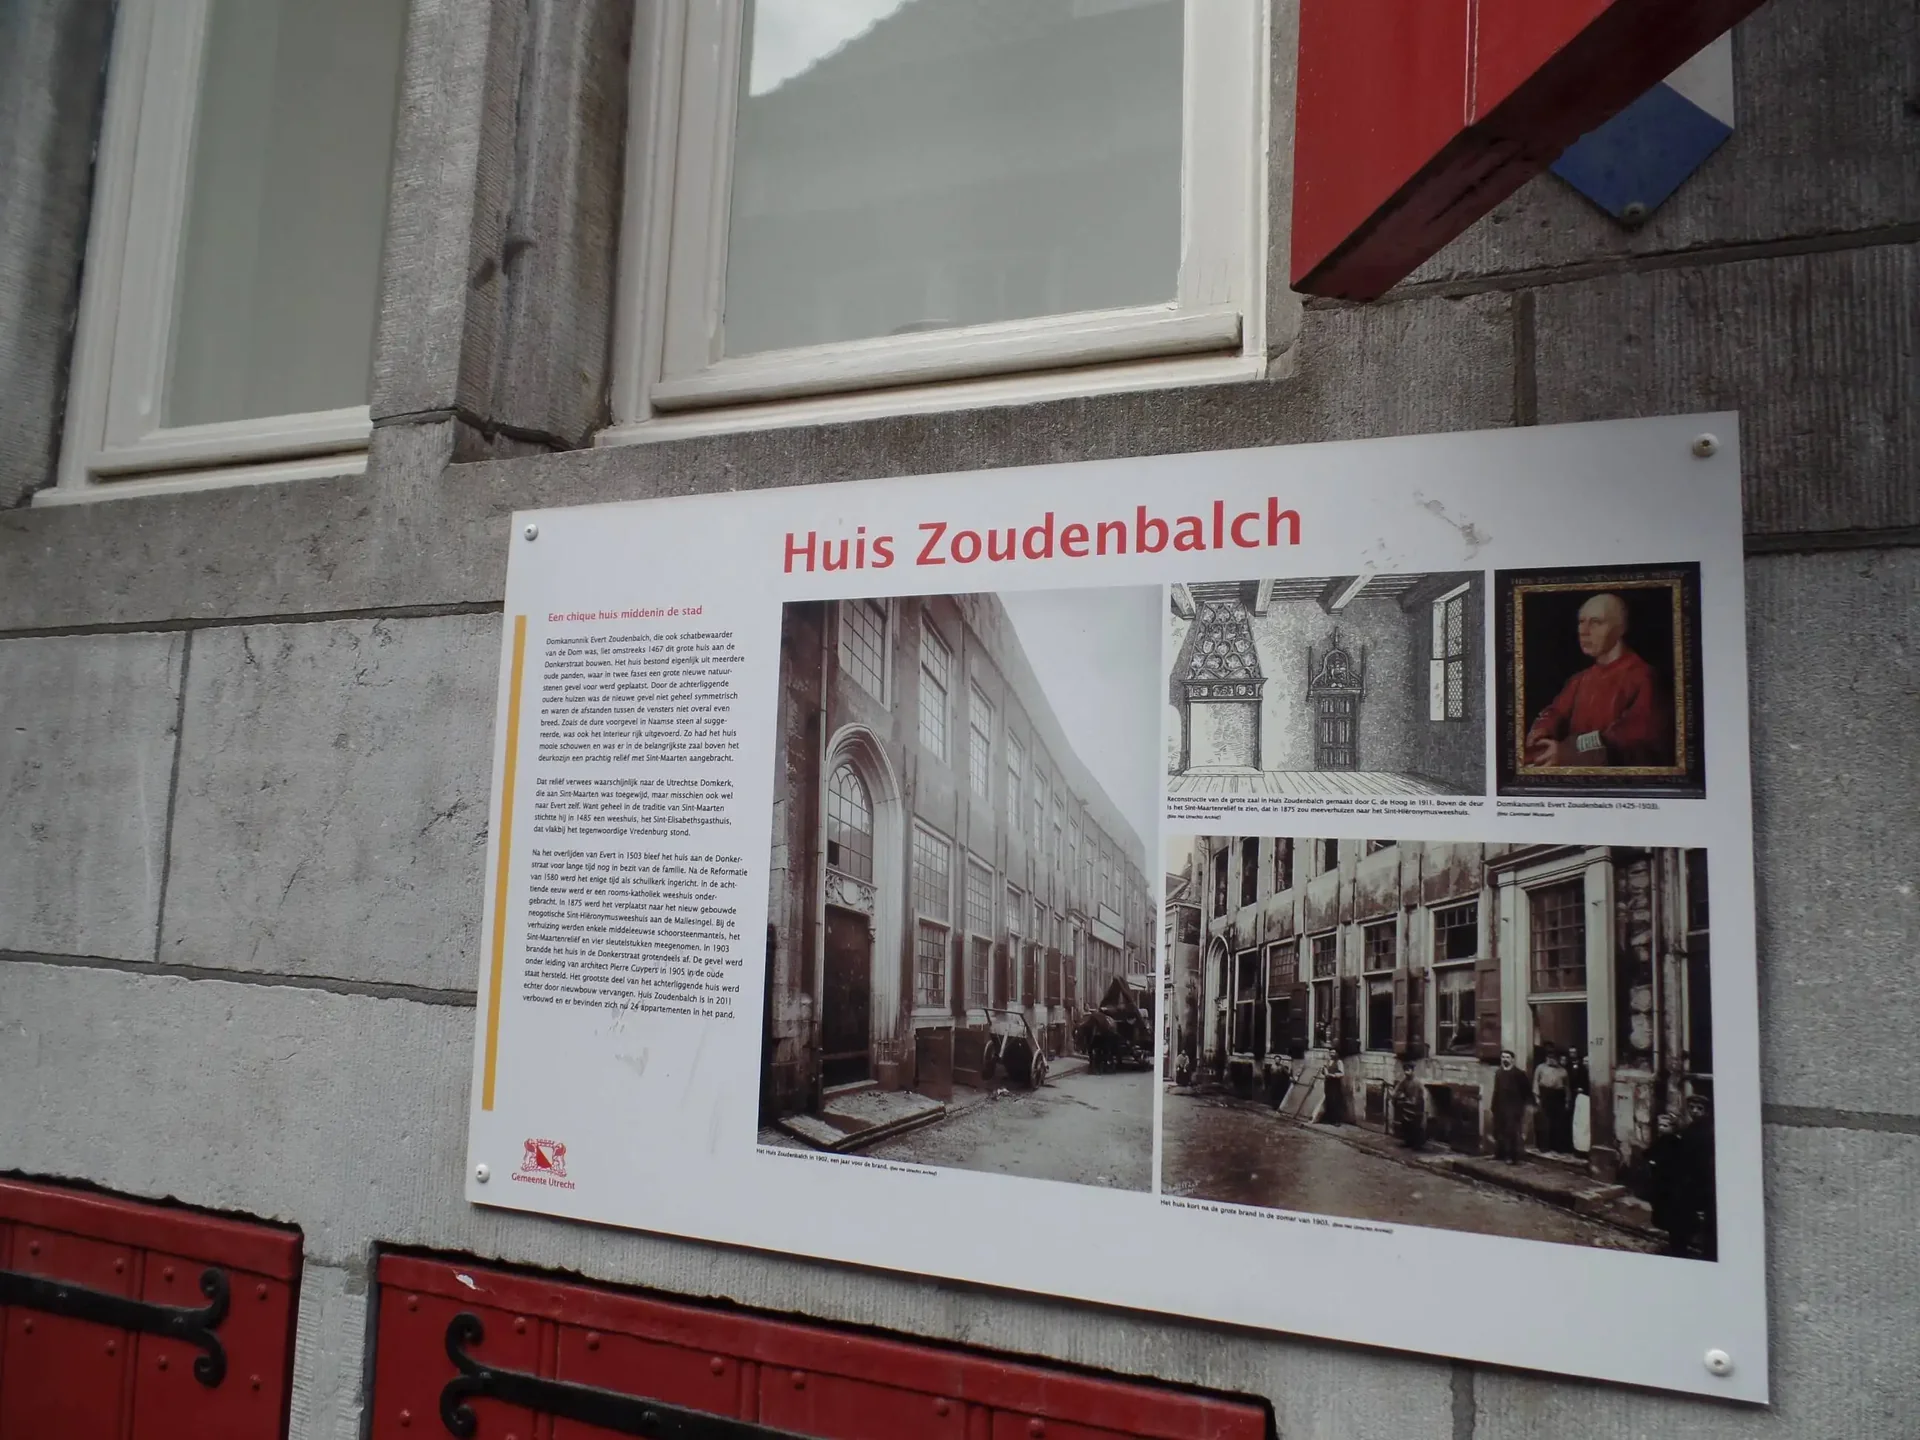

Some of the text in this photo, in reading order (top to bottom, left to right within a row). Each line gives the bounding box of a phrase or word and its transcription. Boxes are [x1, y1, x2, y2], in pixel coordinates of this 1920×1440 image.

[784, 497, 1302, 573] Huis Zoudenbalch
[548, 605, 703, 623] Een chique huis middenin de stad
[546, 636, 589, 646] Domkanunnik
[590, 636, 607, 644] Evert
[680, 630, 733, 640] schatbewaarder
[612, 645, 664, 655] omstreeks 1467
[544, 660, 584, 669] Donkerstraat
[643, 656, 670, 666] bestond
[671, 656, 699, 666] eigenlijk
[712, 654, 745, 663] meerdere
[679, 680, 729, 690] achterliggende
[542, 691, 738, 703] oudere huizen nieuwe geheel symmetrisch
[580, 706, 612, 715] afstanden
[691, 704, 712, 713] overal
[606, 717, 674, 728] voorgevel Naamse
[603, 730, 630, 738] interieur
[560, 741, 687, 752] schouwen belangrijkste
[538, 754, 571, 763] deurkozijn
[585, 754, 612, 764] prachtig
[646, 754, 688, 762] Sint-Maarten
[594, 778, 638, 788] waarschijnlijk
[666, 778, 698, 787] Utrechtse
[559, 789, 599, 798] Sint-Maarten
[670, 791, 704, 800] misschien
[550, 801, 725, 812] Evert geheel traditie Sint-Maarten
[534, 813, 557, 822] stichtte
[577, 814, 592, 822] 1485
[545, 825, 668, 838] vlakbij tegenwoordige Vredenburg
[553, 849, 585, 859] overlijden
[599, 850, 616, 859] Evert
[626, 851, 642, 860] 1503
[674, 853, 688, 862] huis
[531, 861, 549, 869] straat
[710, 867, 748, 877] Reformatie
[544, 873, 559, 881] 1580
[633, 877, 666, 886] schuilkerk
[529, 885, 693, 900] tiende werd rooms-katholiek weeshuis
[568, 898, 583, 907] 1875
[584, 900, 601, 908] werd
[614, 901, 647, 911] verplaatst
[700, 905, 737, 915] gebouwde
[528, 910, 565, 919] neogotische
[527, 921, 560, 932] verhuizing
[561, 924, 585, 932] werden
[586, 924, 607, 933] enkele
[609, 926, 656, 936] middeleeuwse
[606, 938, 653, 948] sleutelstukken
[713, 944, 730, 953] 1903
[526, 944, 724, 967] brandde Donkerstraat grotendeels gevel
[545, 958, 686, 976] leiding architect Pierre Cuypers 1905
[570, 973, 581, 981] Het
[582, 974, 610, 983] grootste
[654, 979, 703, 991] achterliggende
[524, 981, 543, 991] echter
[560, 985, 597, 995] nieuwbouw
[654, 991, 698, 1003] Zoudenbalch
[716, 996, 732, 1006] 2011
[523, 994, 692, 1015] verbouwd bevinden 24 appartementen
[512, 1173, 575, 1190] Gemeente Utrecht
